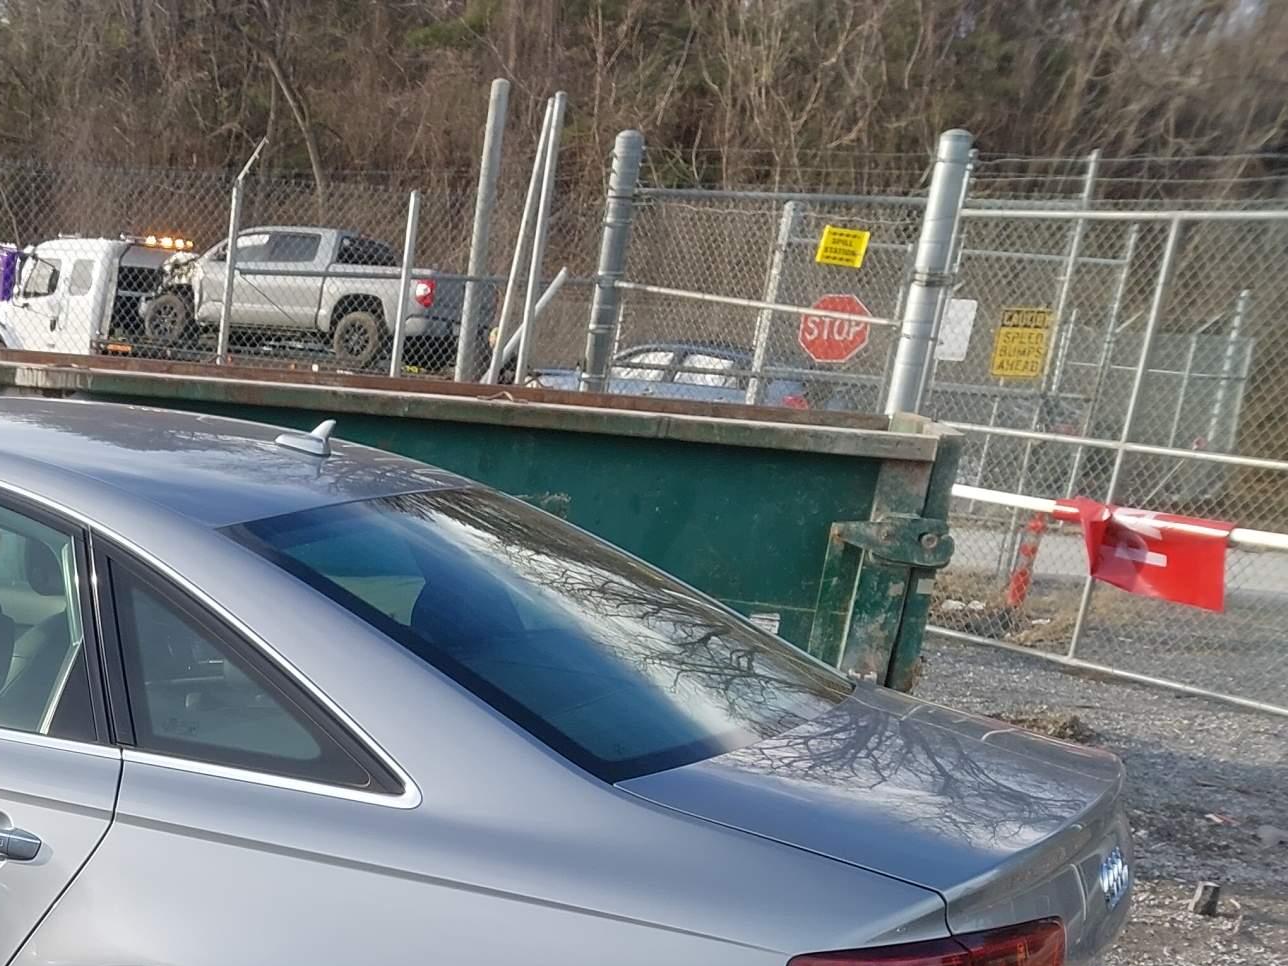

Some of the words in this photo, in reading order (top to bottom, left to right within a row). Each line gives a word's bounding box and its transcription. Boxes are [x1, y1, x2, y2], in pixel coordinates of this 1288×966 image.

[804, 316, 865, 341] STOP
[1003, 331, 1043, 345] SPEED
[999, 345, 1042, 358] BUMPS
[996, 359, 1040, 373] AHEAD
